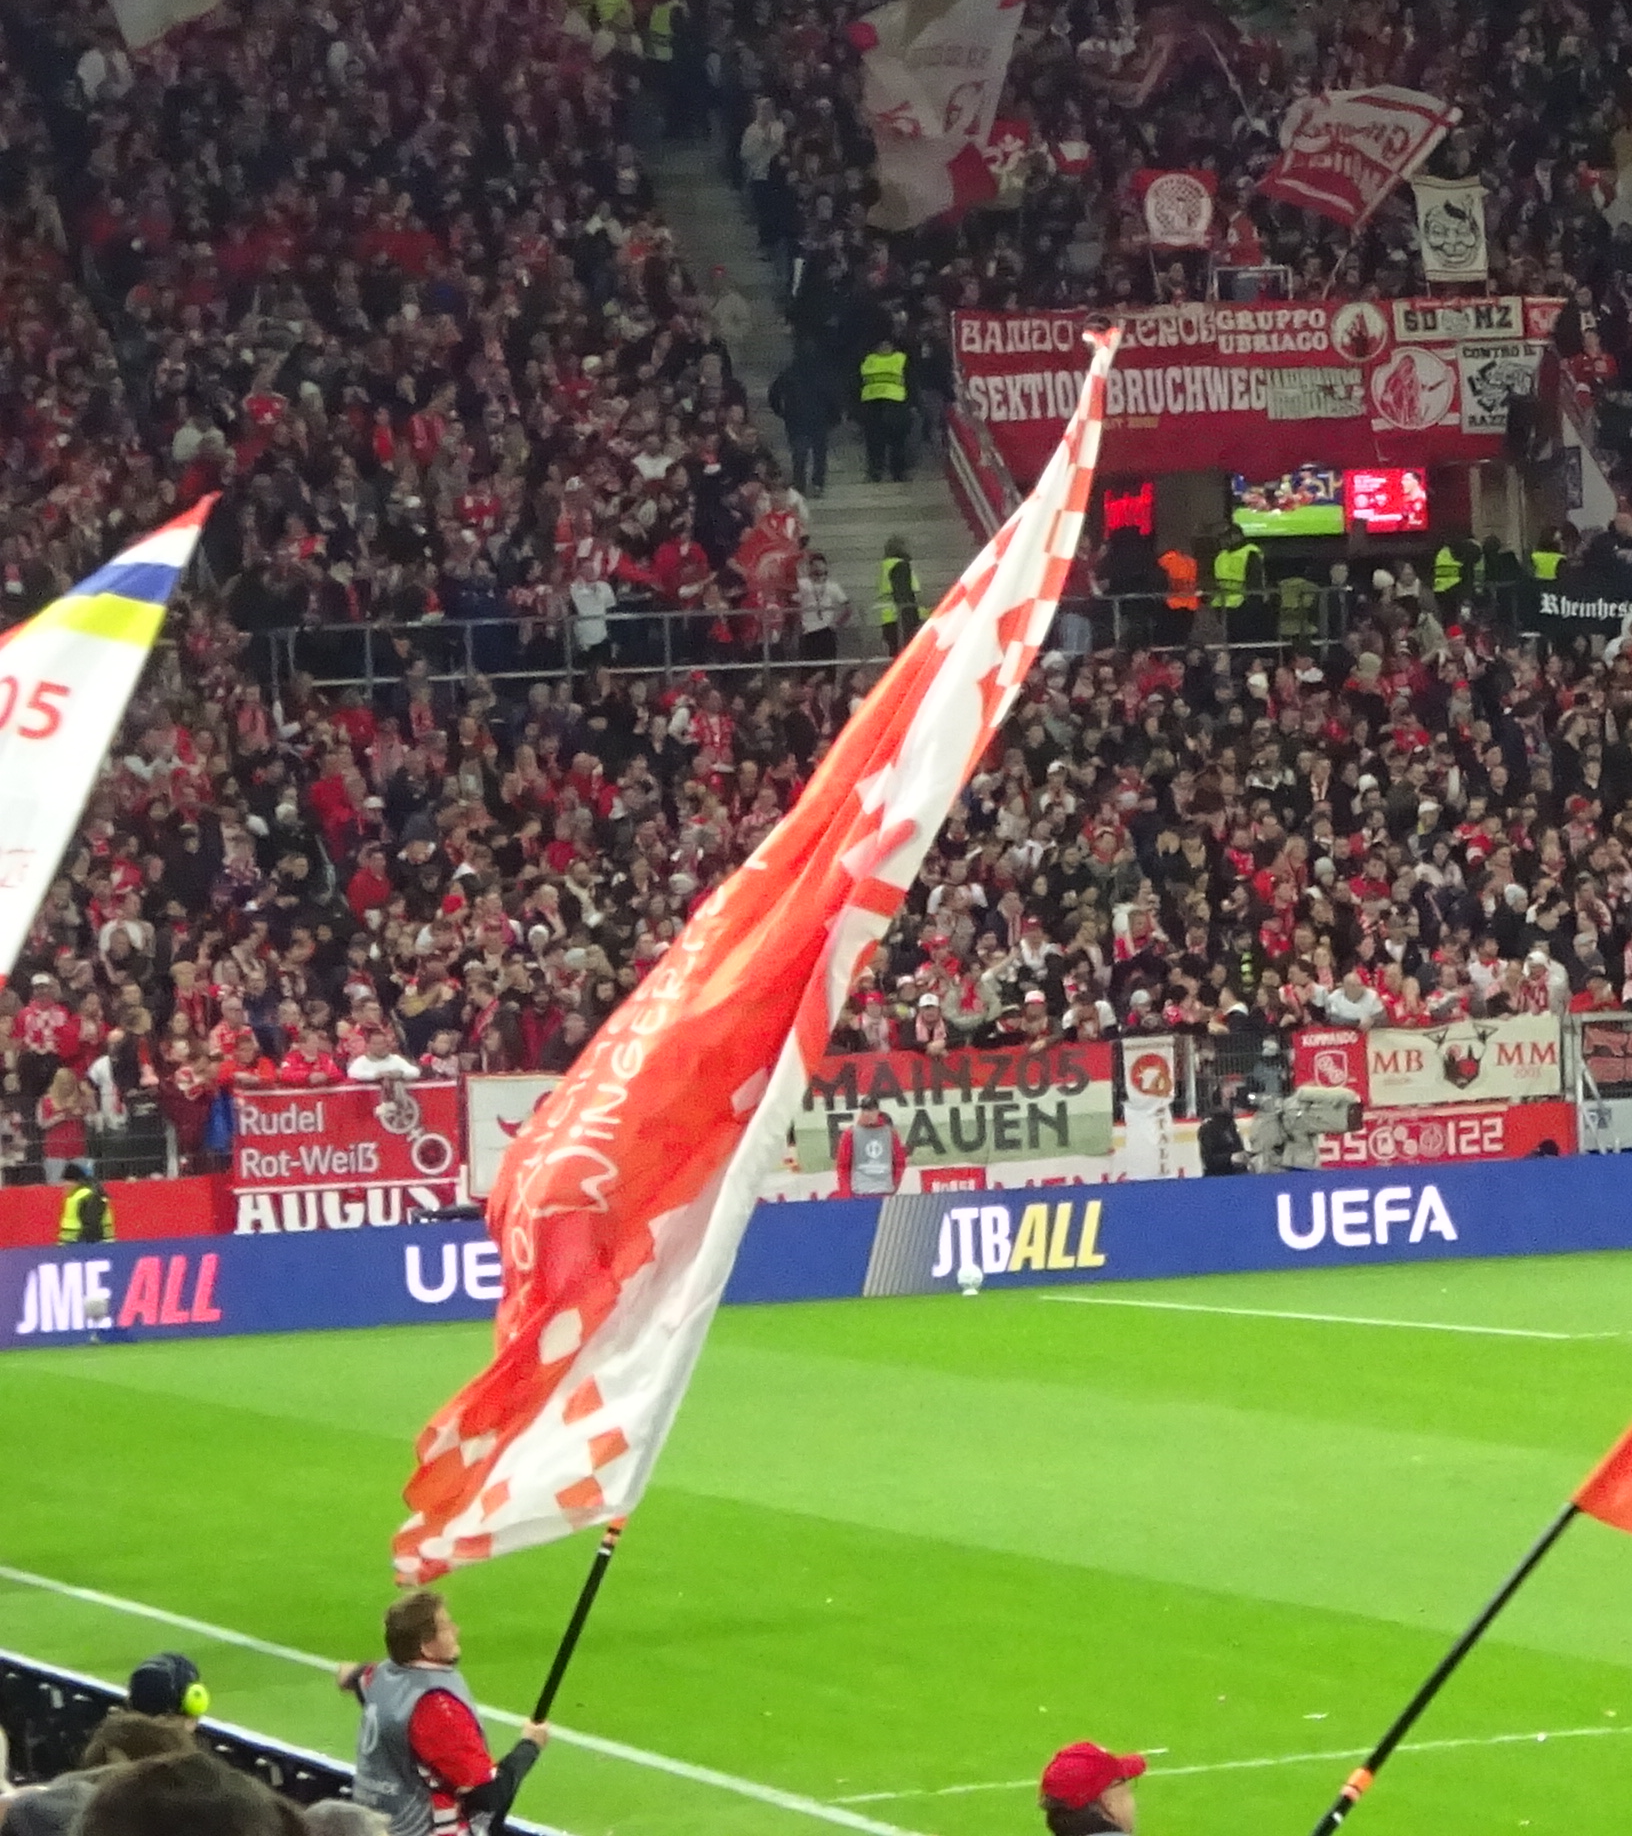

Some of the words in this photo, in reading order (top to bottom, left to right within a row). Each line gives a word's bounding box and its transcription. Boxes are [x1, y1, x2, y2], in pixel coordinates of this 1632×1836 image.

[1216, 307, 1327, 332] GRUPPO
[1218, 330, 1329, 354] UBRIACO
[1462, 346, 1520, 358] CONTRO
[1106, 364, 1268, 414] BRUCHWEG
[1372, 1049, 1424, 1074] MB
[1496, 1041, 1558, 1066] MM
[239, 1100, 324, 1136] Rudel
[826, 1100, 1070, 1160] FAUEN
[240, 1141, 380, 1180] Rot-Weiß
[1276, 1184, 1458, 1250] UEFA
[116, 1253, 223, 1329] ALL
[404, 1241, 505, 1305] UE
